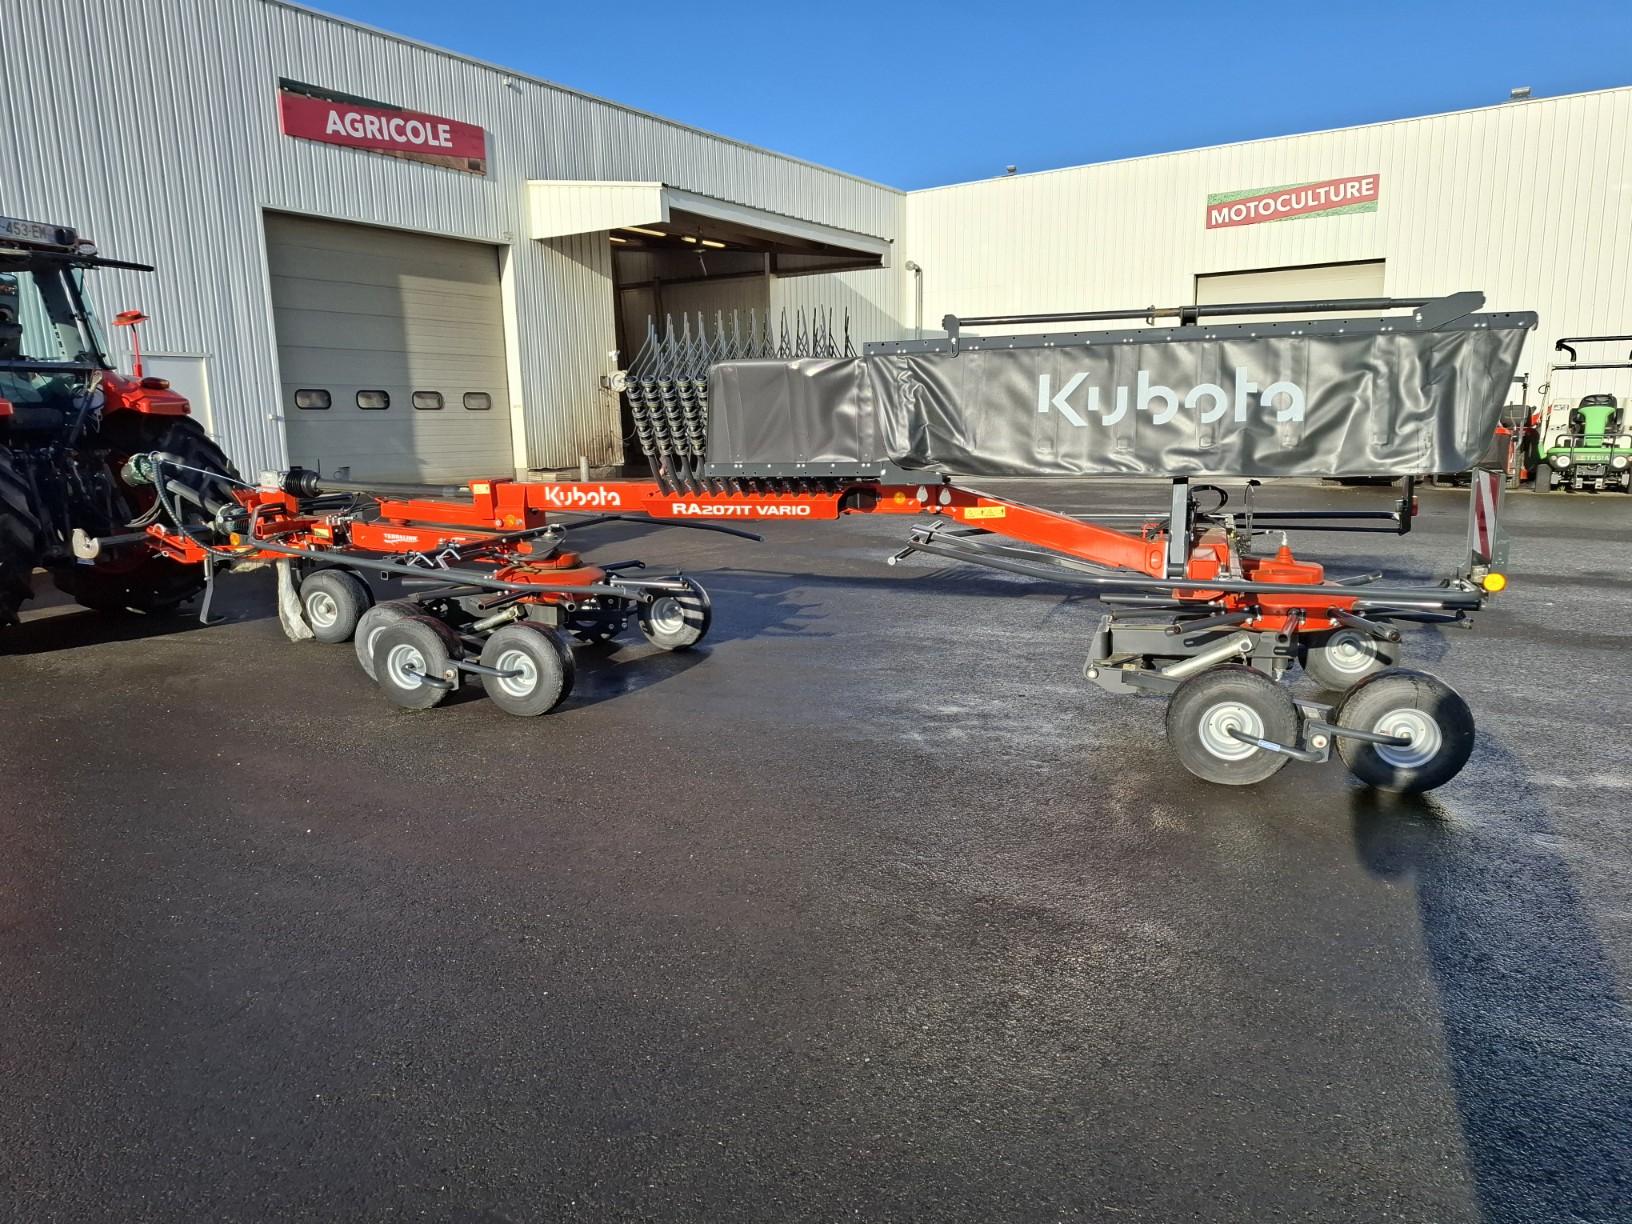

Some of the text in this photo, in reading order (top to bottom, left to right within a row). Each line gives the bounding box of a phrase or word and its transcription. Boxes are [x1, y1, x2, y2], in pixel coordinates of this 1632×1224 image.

[325, 110, 453, 148] AGRICOLE
[1211, 178, 1374, 226] MOTOCULTURE
[1038, 366, 1305, 427] Kubota
[545, 486, 621, 506] Kubota
[757, 505, 811, 516] VARIO
